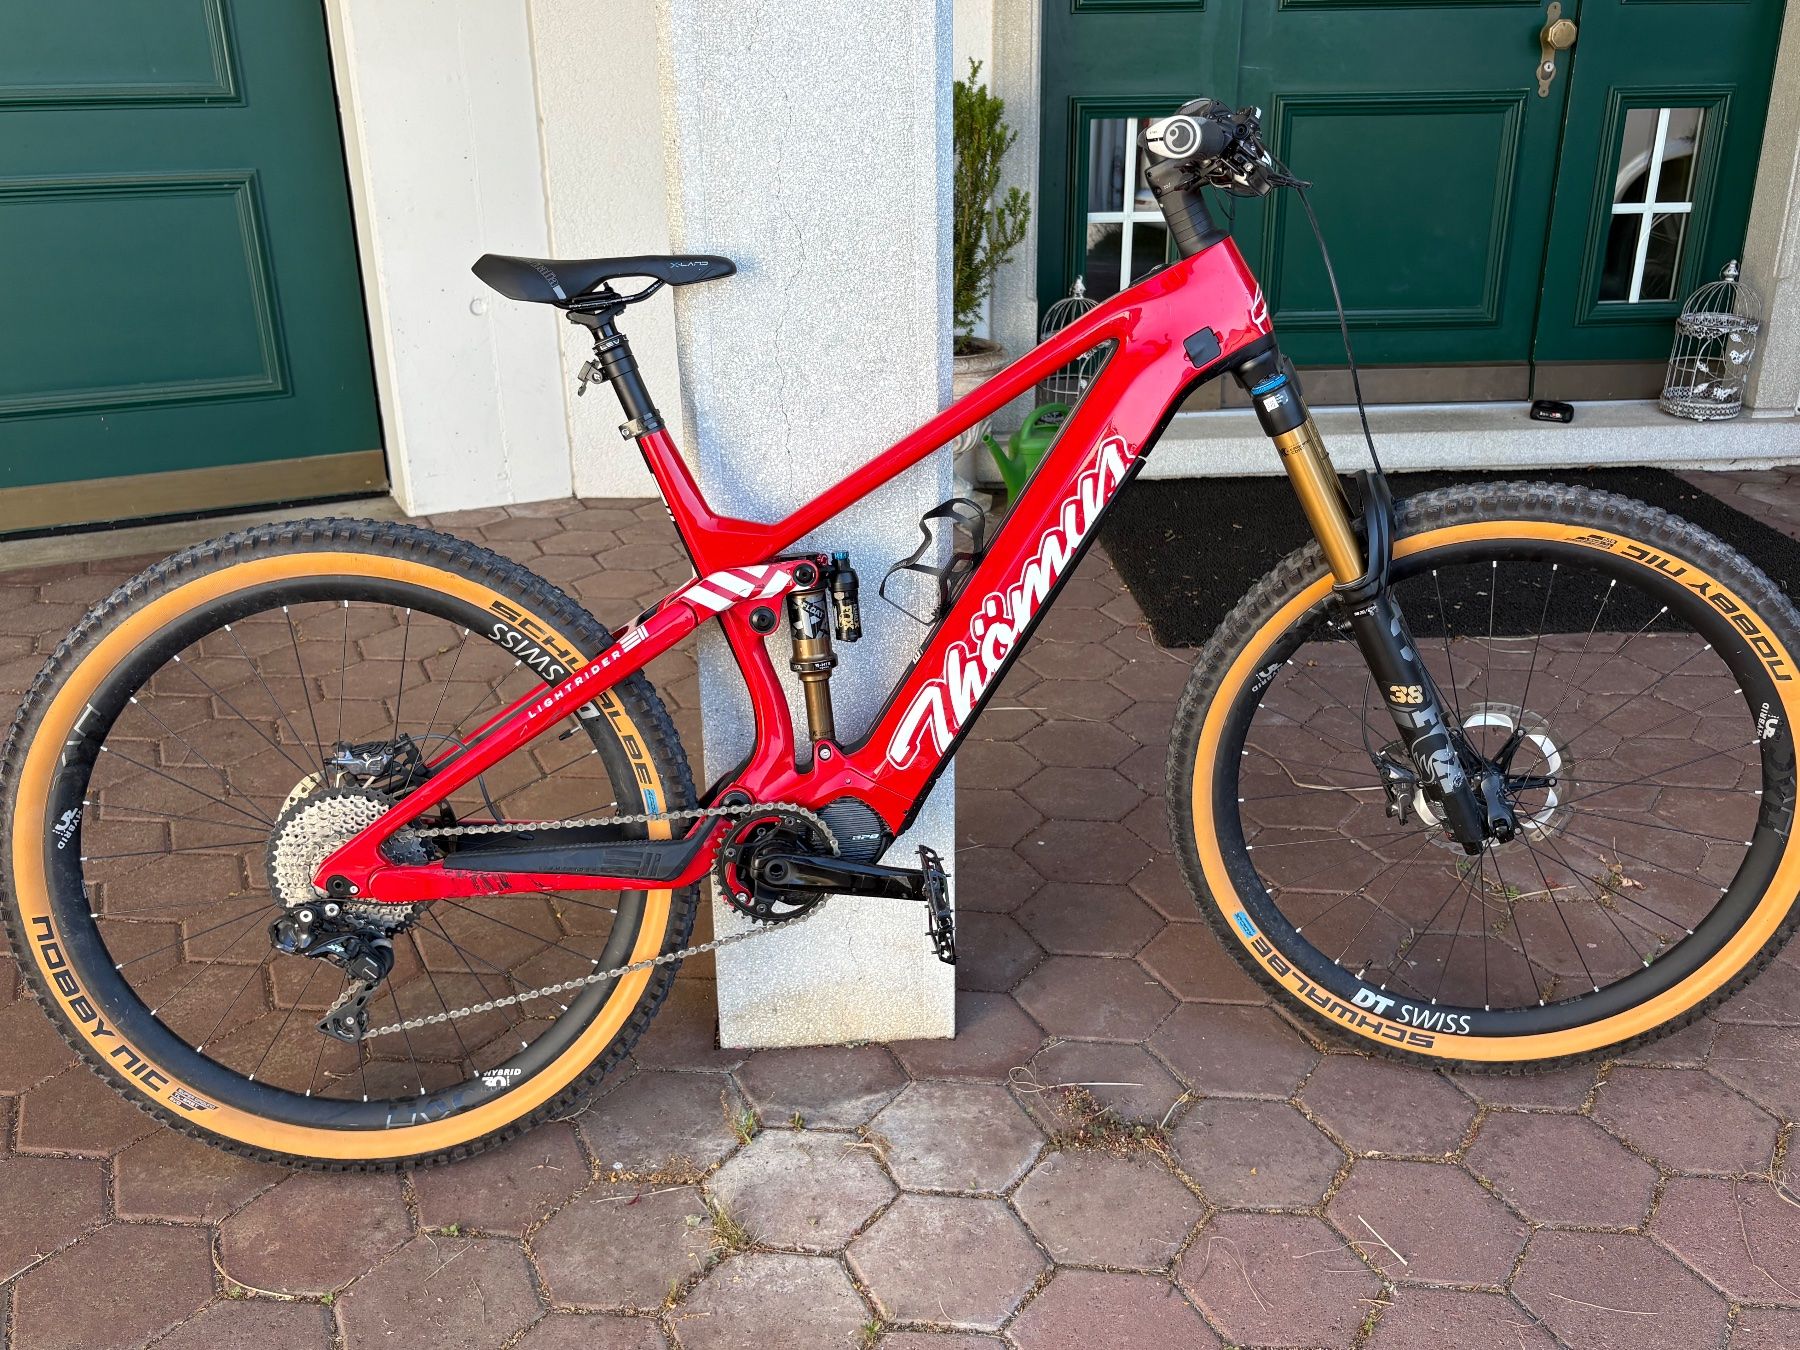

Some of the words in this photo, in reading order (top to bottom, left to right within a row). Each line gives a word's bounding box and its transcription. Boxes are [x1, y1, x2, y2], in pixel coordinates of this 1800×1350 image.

[1620, 545, 1688, 578] NIC
[488, 623, 565, 681] SWISS
[1686, 582, 1793, 681] NOBBY
[528, 650, 622, 719] LIGHTRIDER
[1389, 685, 1424, 705] 38
[1757, 702, 1770, 737] HYBRID
[57, 809, 83, 850] HYBRID
[32, 916, 115, 1038] NOBBY
[110, 1044, 170, 1093] NIC
[1250, 936, 1436, 1049] SCHWALBE
[1351, 987, 1396, 1015] DT
[1396, 1004, 1471, 1035] SWISS
[483, 1068, 522, 1077] HYBRID
